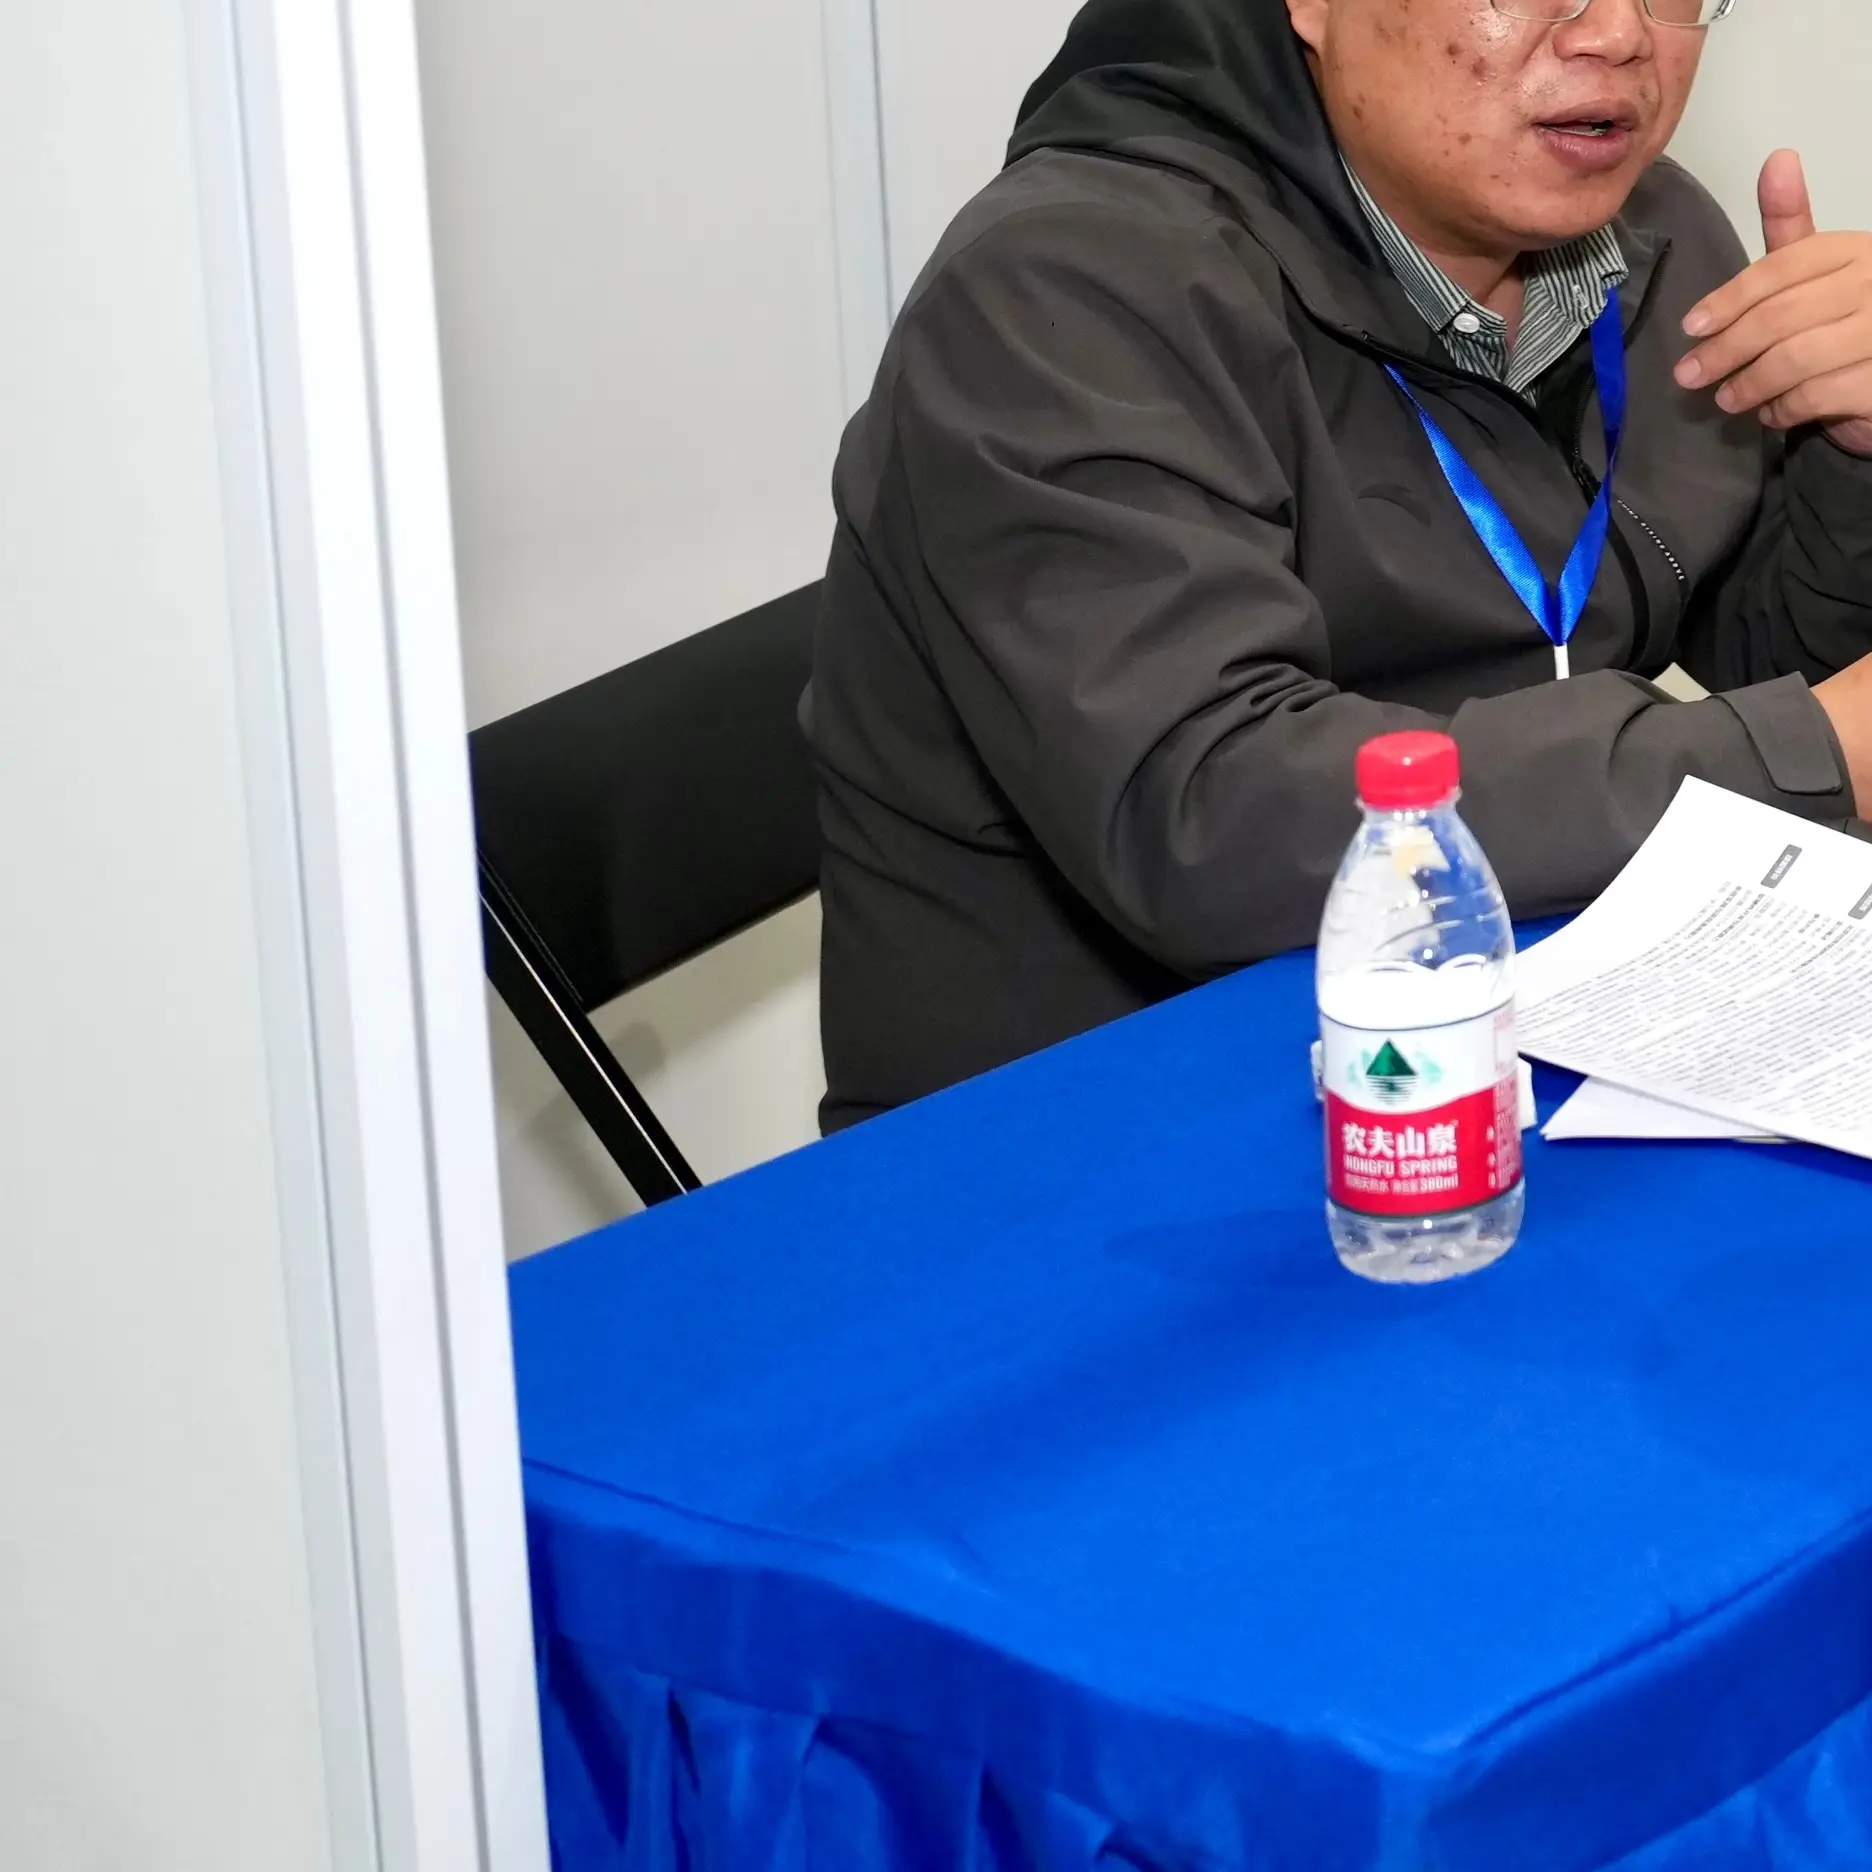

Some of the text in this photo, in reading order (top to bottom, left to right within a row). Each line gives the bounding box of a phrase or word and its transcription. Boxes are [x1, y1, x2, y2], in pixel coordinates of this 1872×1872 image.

[1342, 1122, 1457, 1160] 农夫山泉
[1400, 1155, 1457, 1178] SPRING
